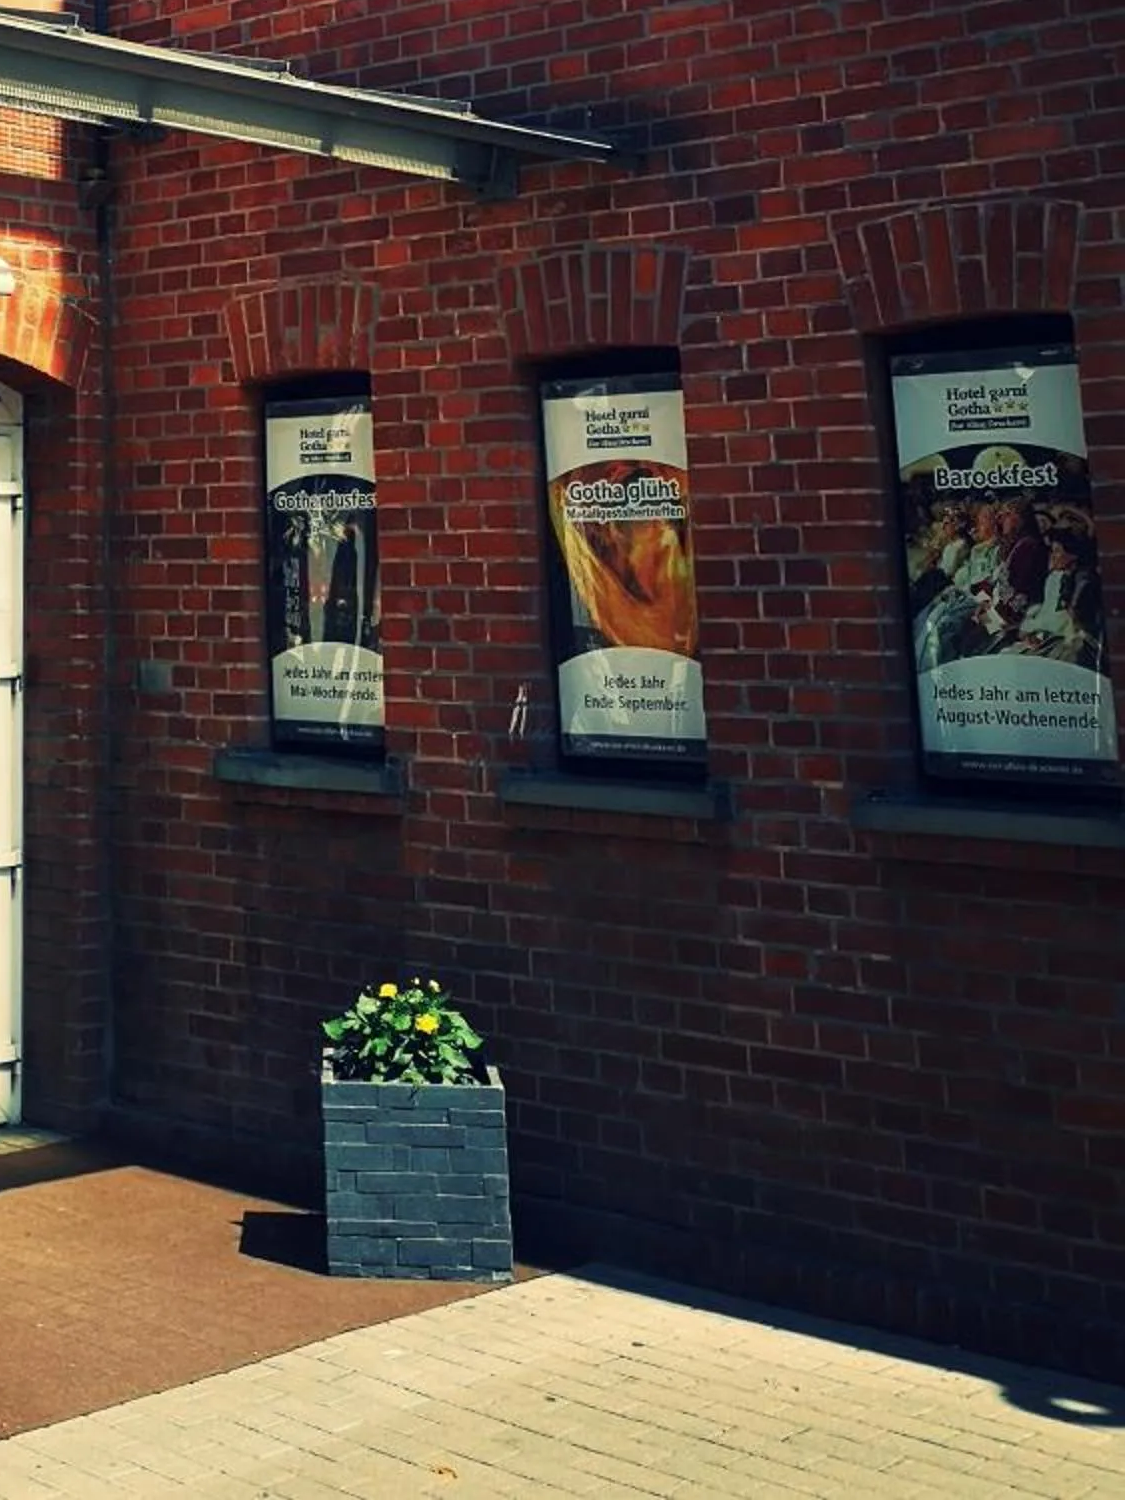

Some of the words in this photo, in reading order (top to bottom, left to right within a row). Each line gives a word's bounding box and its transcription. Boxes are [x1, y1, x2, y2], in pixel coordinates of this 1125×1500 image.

[946, 385, 985, 401] Hotel
[989, 383, 1029, 402] garni
[586, 408, 616, 422] Hotel
[619, 406, 649, 424] garni
[948, 402, 990, 416] Gotha
[587, 423, 620, 435] Gotha
[936, 463, 1055, 487] Barockfest
[275, 490, 377, 510] Gothardusfes
[569, 480, 624, 501] Gotha
[628, 478, 678, 504] glüht
[604, 674, 636, 689] Jedes
[640, 675, 665, 689] Jahr
[584, 694, 613, 709] Ende
[933, 684, 974, 701] Jedes
[979, 685, 1009, 701] Jahr
[1015, 689, 1040, 703] am
[1045, 687, 1101, 705] letzten
